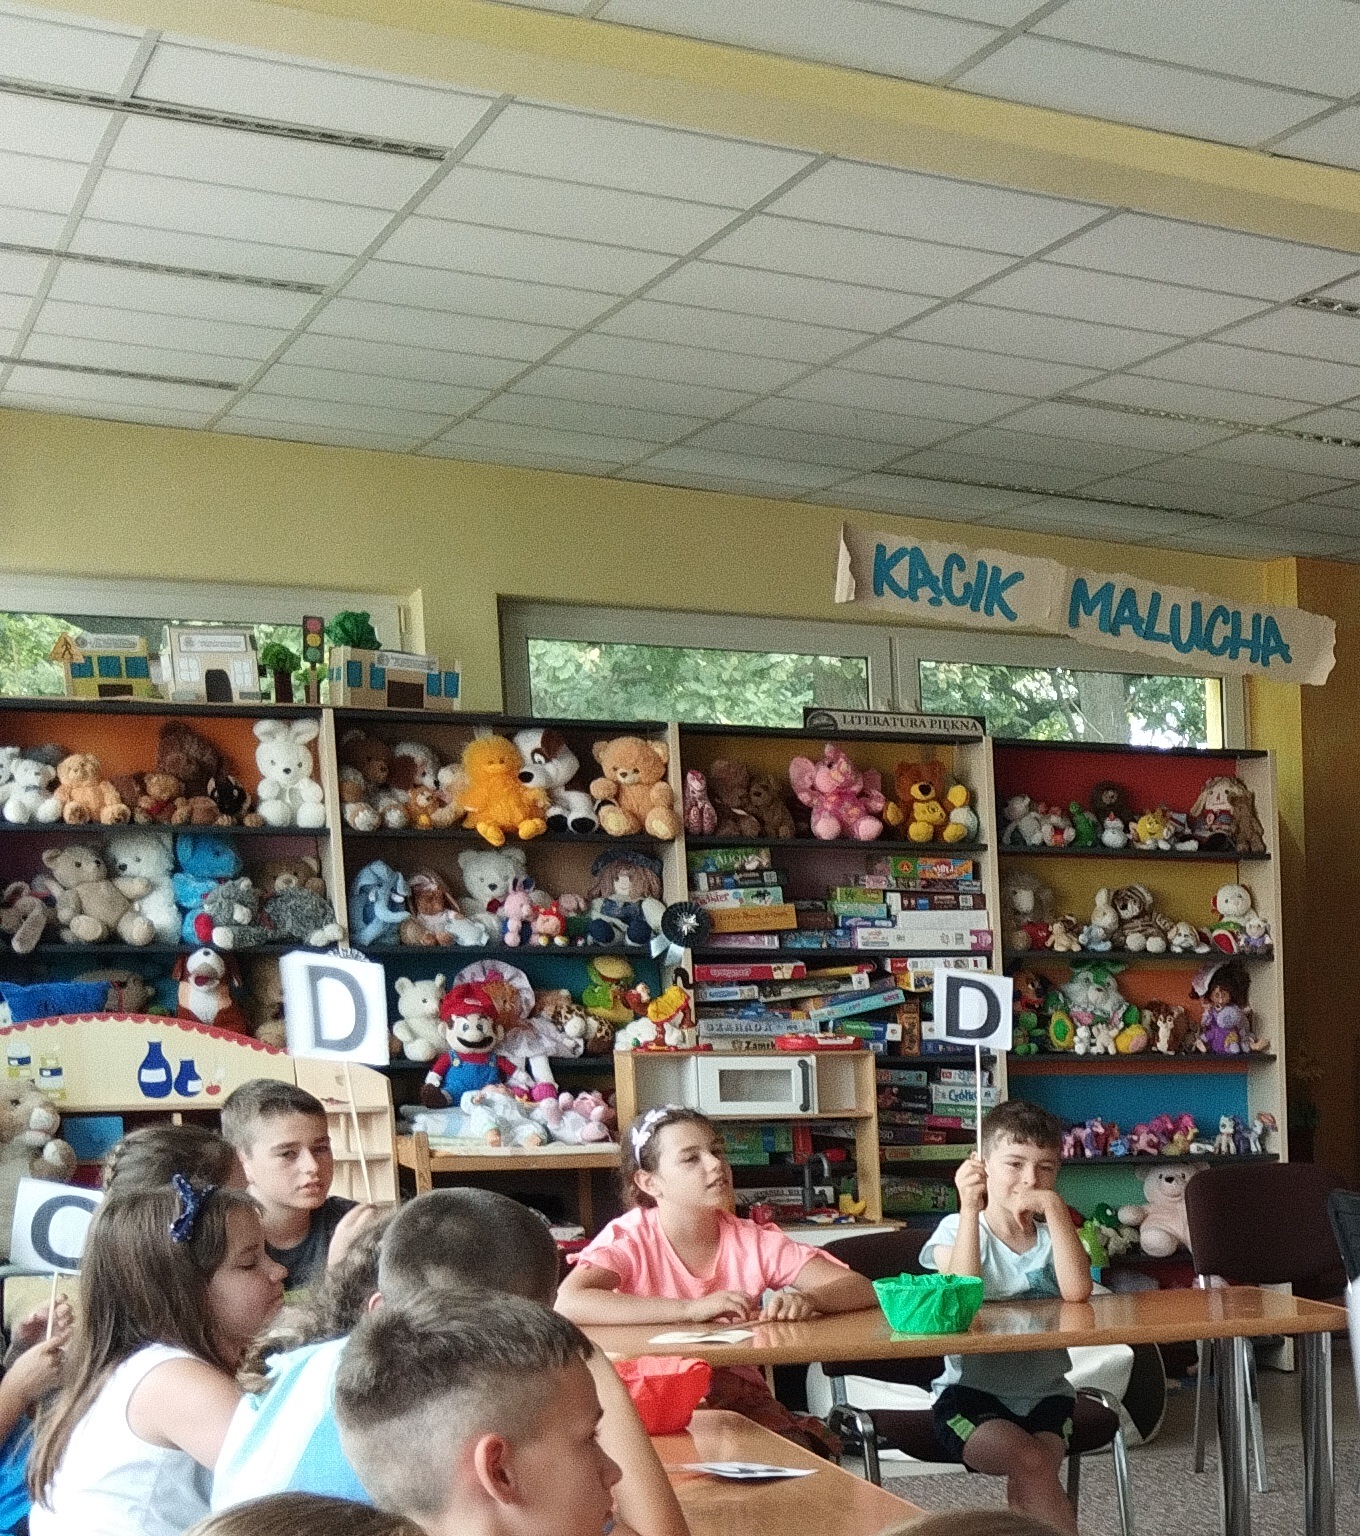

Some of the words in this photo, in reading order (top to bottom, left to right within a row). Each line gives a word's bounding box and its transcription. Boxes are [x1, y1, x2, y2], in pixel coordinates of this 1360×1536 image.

[873, 543, 1025, 622] KĄCIK
[1068, 577, 1293, 667] MALUCHA
[842, 714, 926, 728] LITERATURA
[930, 719, 979, 733] PIĘKNA
[307, 965, 367, 1052] D
[945, 975, 1001, 1039] D
[31, 1194, 101, 1269] C
